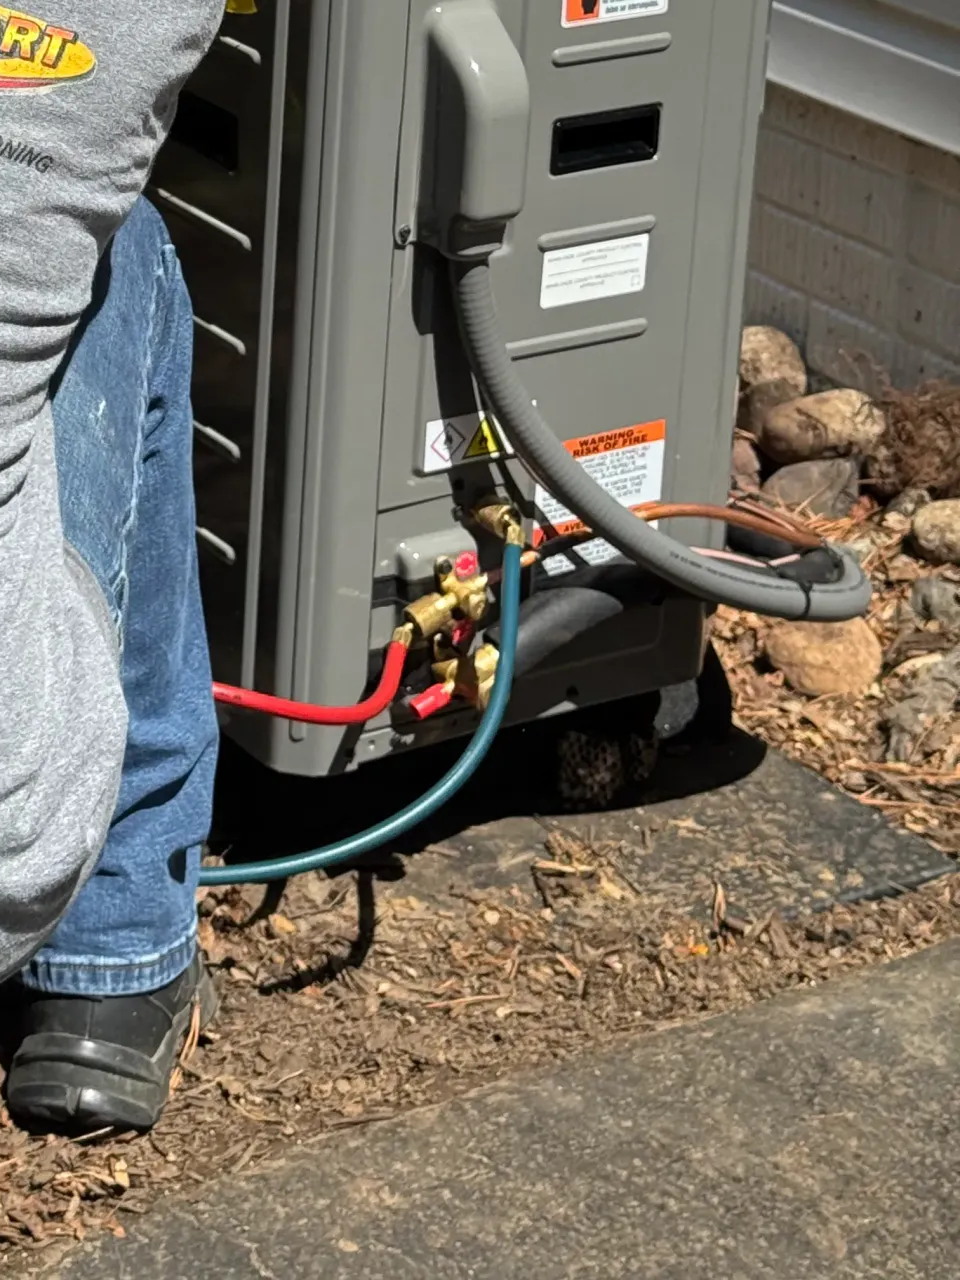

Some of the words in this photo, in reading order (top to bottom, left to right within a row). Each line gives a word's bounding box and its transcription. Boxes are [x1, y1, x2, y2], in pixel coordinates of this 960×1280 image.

[573, 446, 600, 457] RISK
[604, 441, 620, 450] OF
[621, 434, 648, 447] FIRE
[579, 429, 634, 447] WARNING
